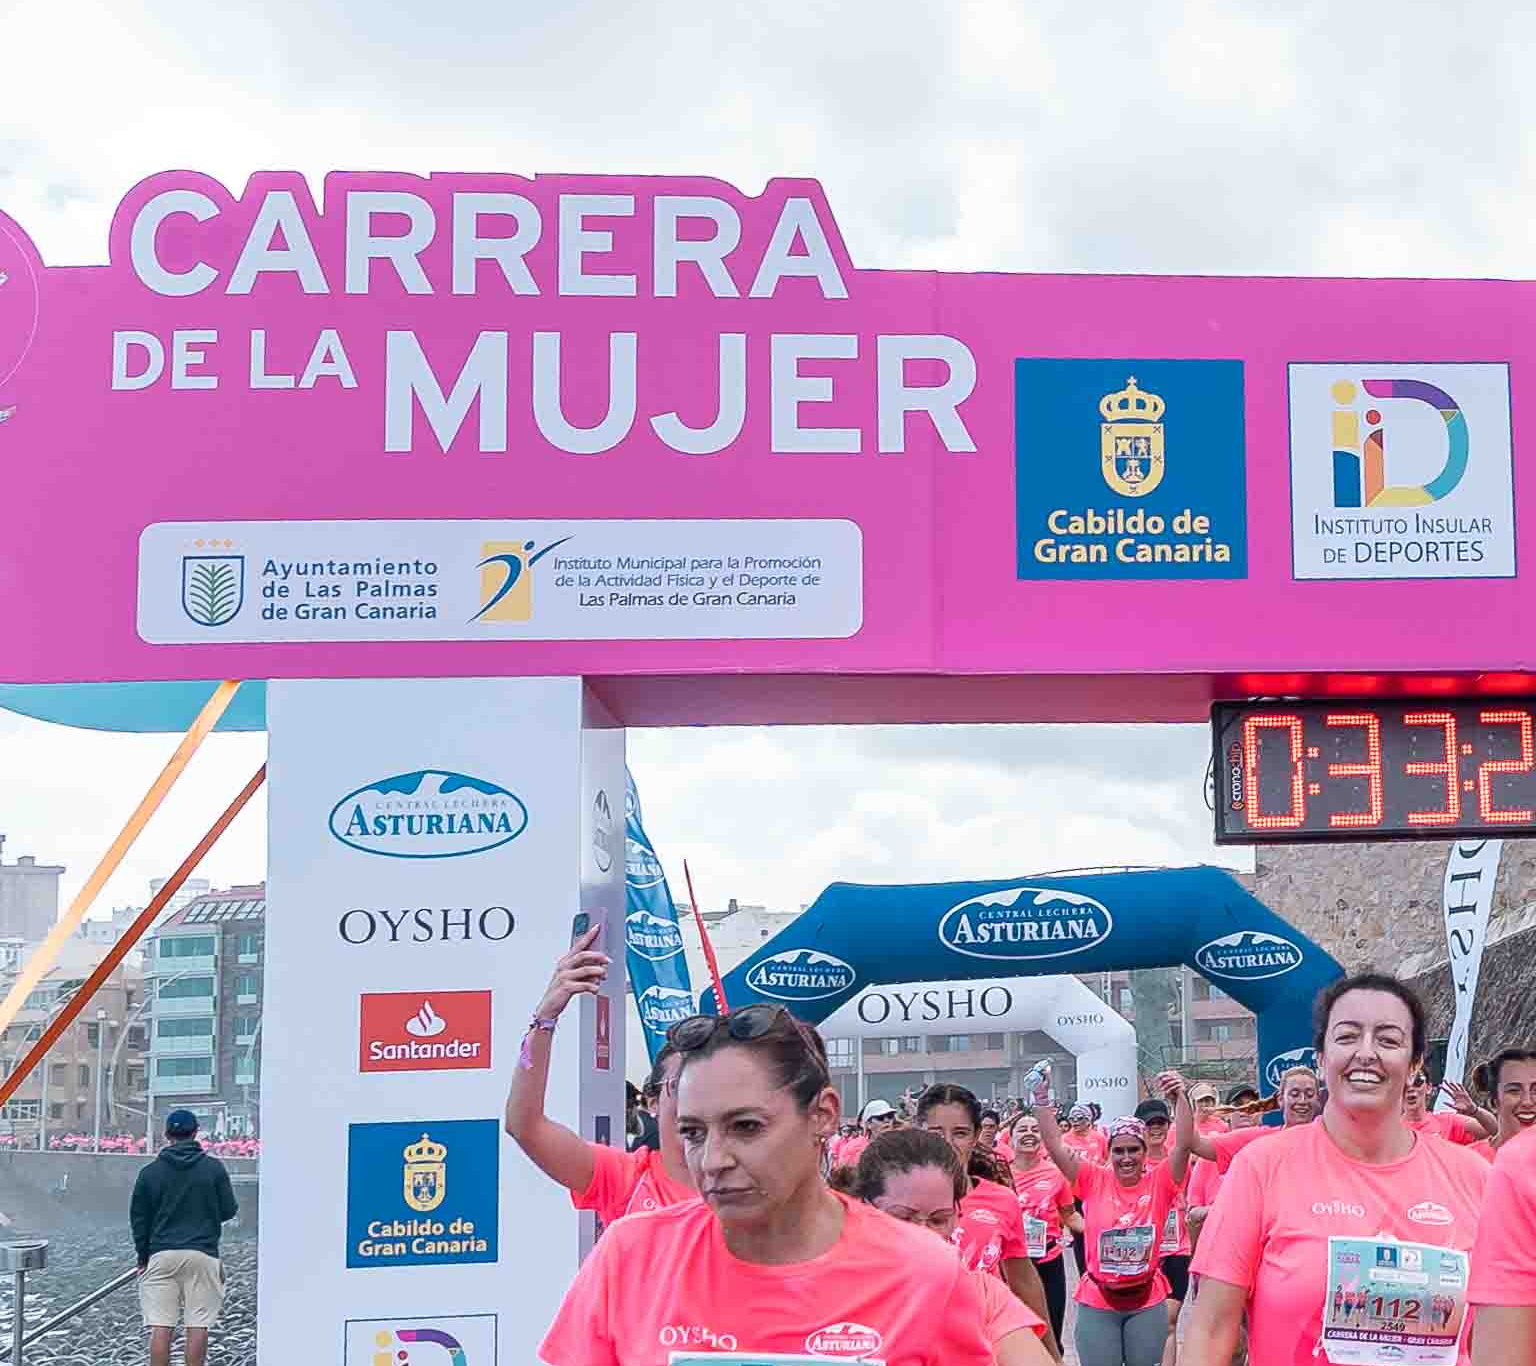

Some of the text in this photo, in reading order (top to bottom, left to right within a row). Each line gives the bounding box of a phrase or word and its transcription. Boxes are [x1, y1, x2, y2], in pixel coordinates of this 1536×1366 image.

[130, 192, 850, 299] CARRERA
[113, 329, 979, 455] DE LA MUJER
[1047, 508, 1210, 535] Cabildo de
[1313, 512, 1493, 536] INSTITUTO INSULAR
[1034, 536, 1231, 565] Gran Canaria
[1323, 540, 1485, 564] DE DEPORTES
[262, 558, 439, 579] Ayuntamiento
[553, 554, 823, 574] Instituto Municipal para la Promoción
[262, 580, 438, 599] de Las Palmas
[555, 573, 574, 588] de
[576, 573, 591, 588] la
[593, 572, 663, 588] Actividad
[708, 576, 718, 591] y
[721, 572, 736, 588] el
[739, 573, 797, 590] Deporte
[800, 572, 821, 587] de
[579, 590, 797, 607] Las Palmas de Gran Canaria
[262, 601, 438, 621] de Gran Canaria
[344, 803, 513, 837] ASTURIANA
[339, 906, 515, 945] OYSHO
[953, 913, 1100, 946] ASTURIANA
[1205, 949, 1296, 969] ASTURIANA
[753, 965, 847, 988] ASTURIANA
[857, 985, 1013, 1024] OYSHO
[1056, 1013, 1104, 1028] OYSHO
[370, 1039, 481, 1061] Santander
[1084, 1076, 1128, 1090] OYSHO
[367, 1218, 474, 1238] Cabildo de
[358, 1236, 487, 1257] Gran Canaria
[1371, 1296, 1422, 1320] 112
[659, 1325, 738, 1352] OYSHO
